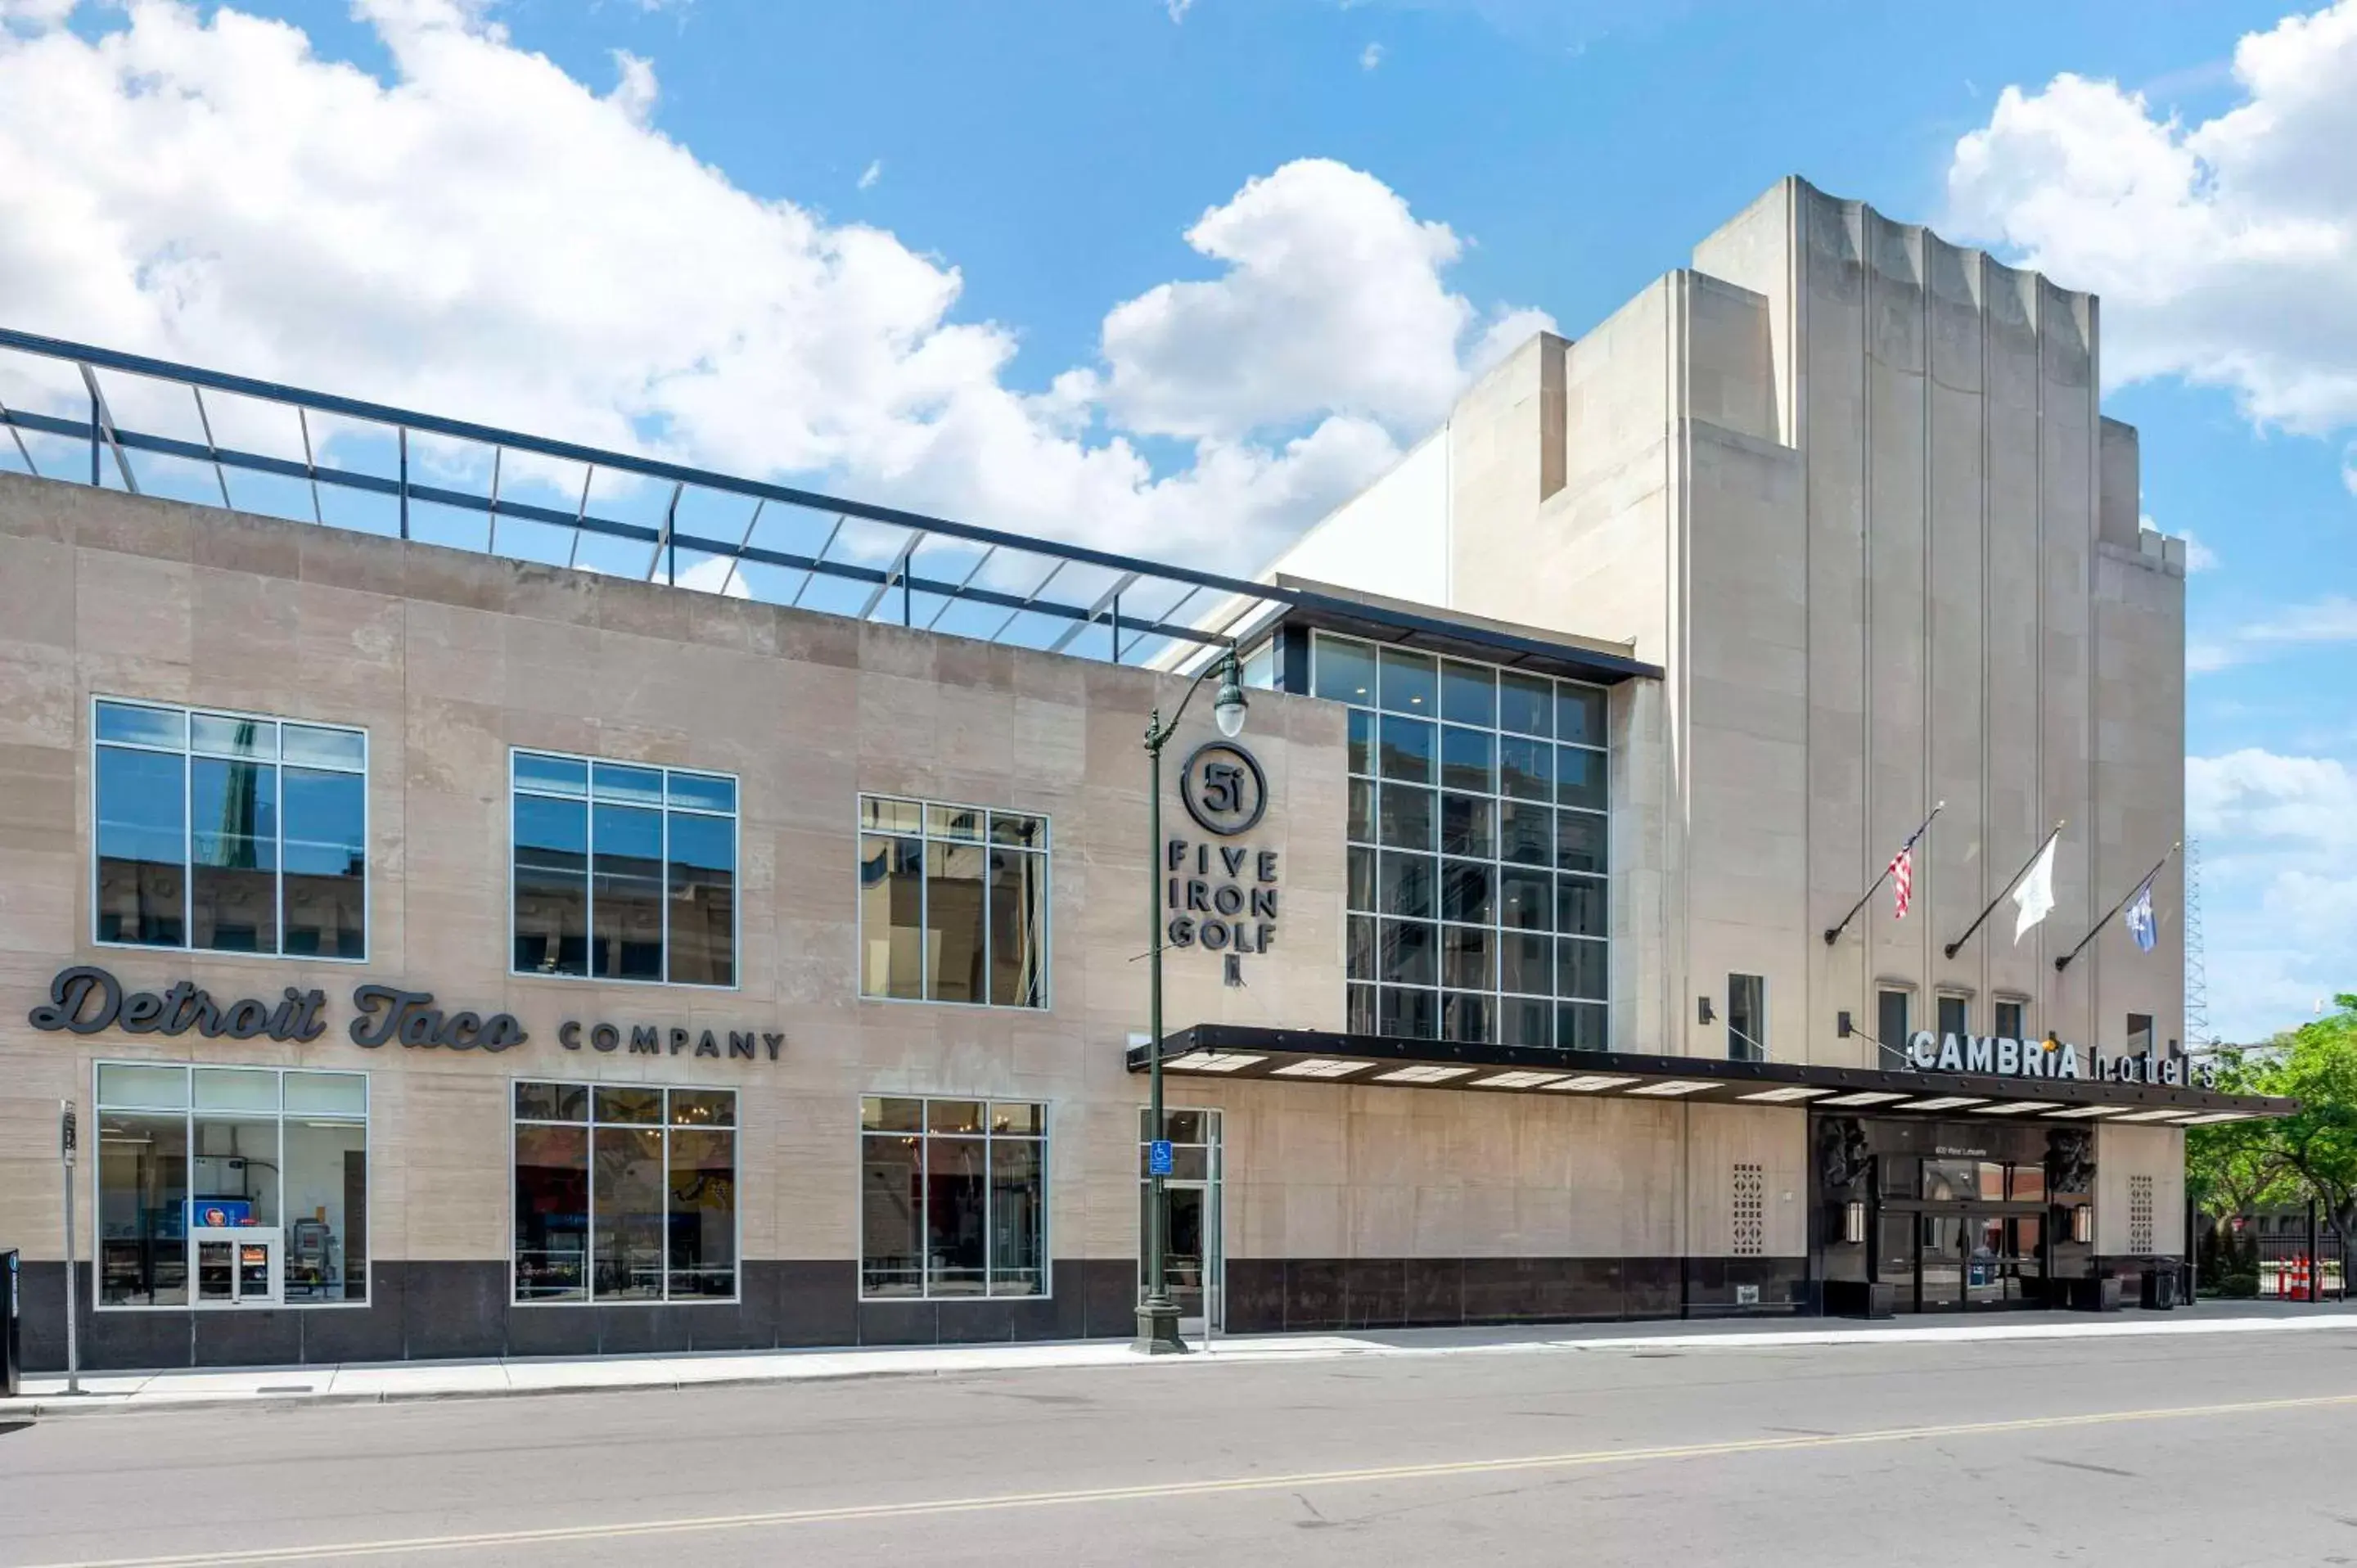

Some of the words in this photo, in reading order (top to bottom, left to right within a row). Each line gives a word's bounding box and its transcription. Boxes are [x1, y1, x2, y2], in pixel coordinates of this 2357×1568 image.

[1169, 840, 1278, 882] FIVE
[1169, 877, 1278, 918] IRON
[1169, 916, 1277, 954] GOLF
[29, 966, 327, 1043] Detroit
[349, 984, 529, 1052] Taco
[559, 1021, 785, 1061] COMPANY
[2089, 1045, 2219, 1089] hotels
